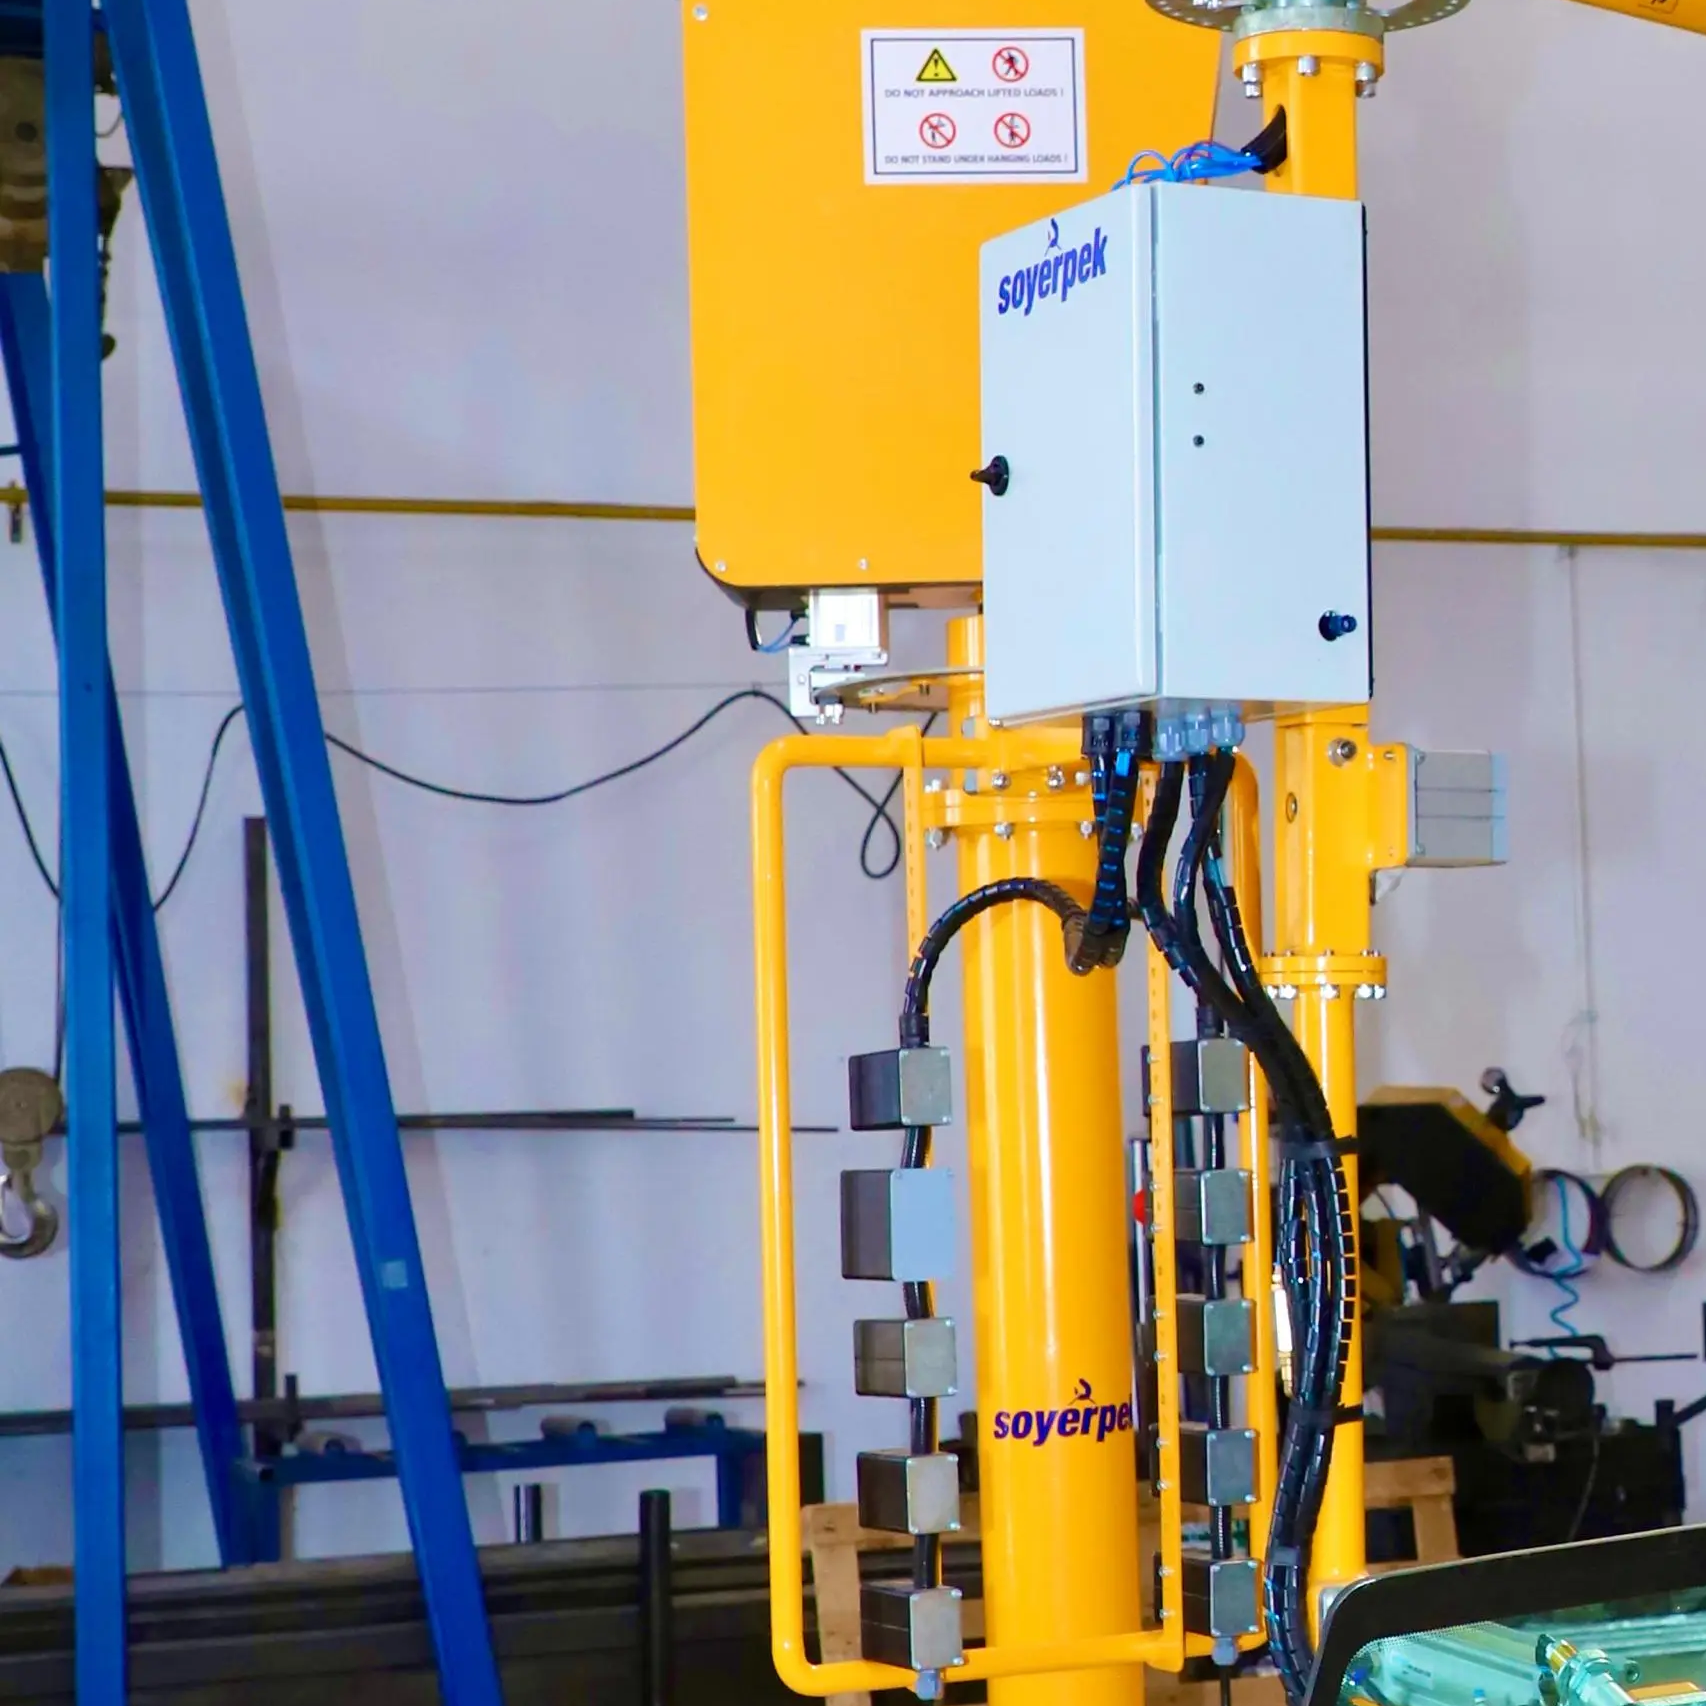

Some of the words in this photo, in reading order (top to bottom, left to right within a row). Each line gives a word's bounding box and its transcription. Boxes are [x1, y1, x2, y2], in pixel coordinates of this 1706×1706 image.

[884, 88, 900, 98] DO
[903, 88, 925, 98] NOT
[928, 88, 985, 98] APPROACH
[987, 88, 1022, 98] LIFTED
[1023, 88, 1057, 98] LOADS
[884, 154, 899, 165] DO
[901, 154, 920, 165] NOT
[922, 154, 951, 165] STAND
[953, 154, 986, 165] UNDER
[987, 154, 1030, 165] HANGING
[1032, 154, 1062, 165] LOADS
[997, 227, 1108, 317] soyerpek
